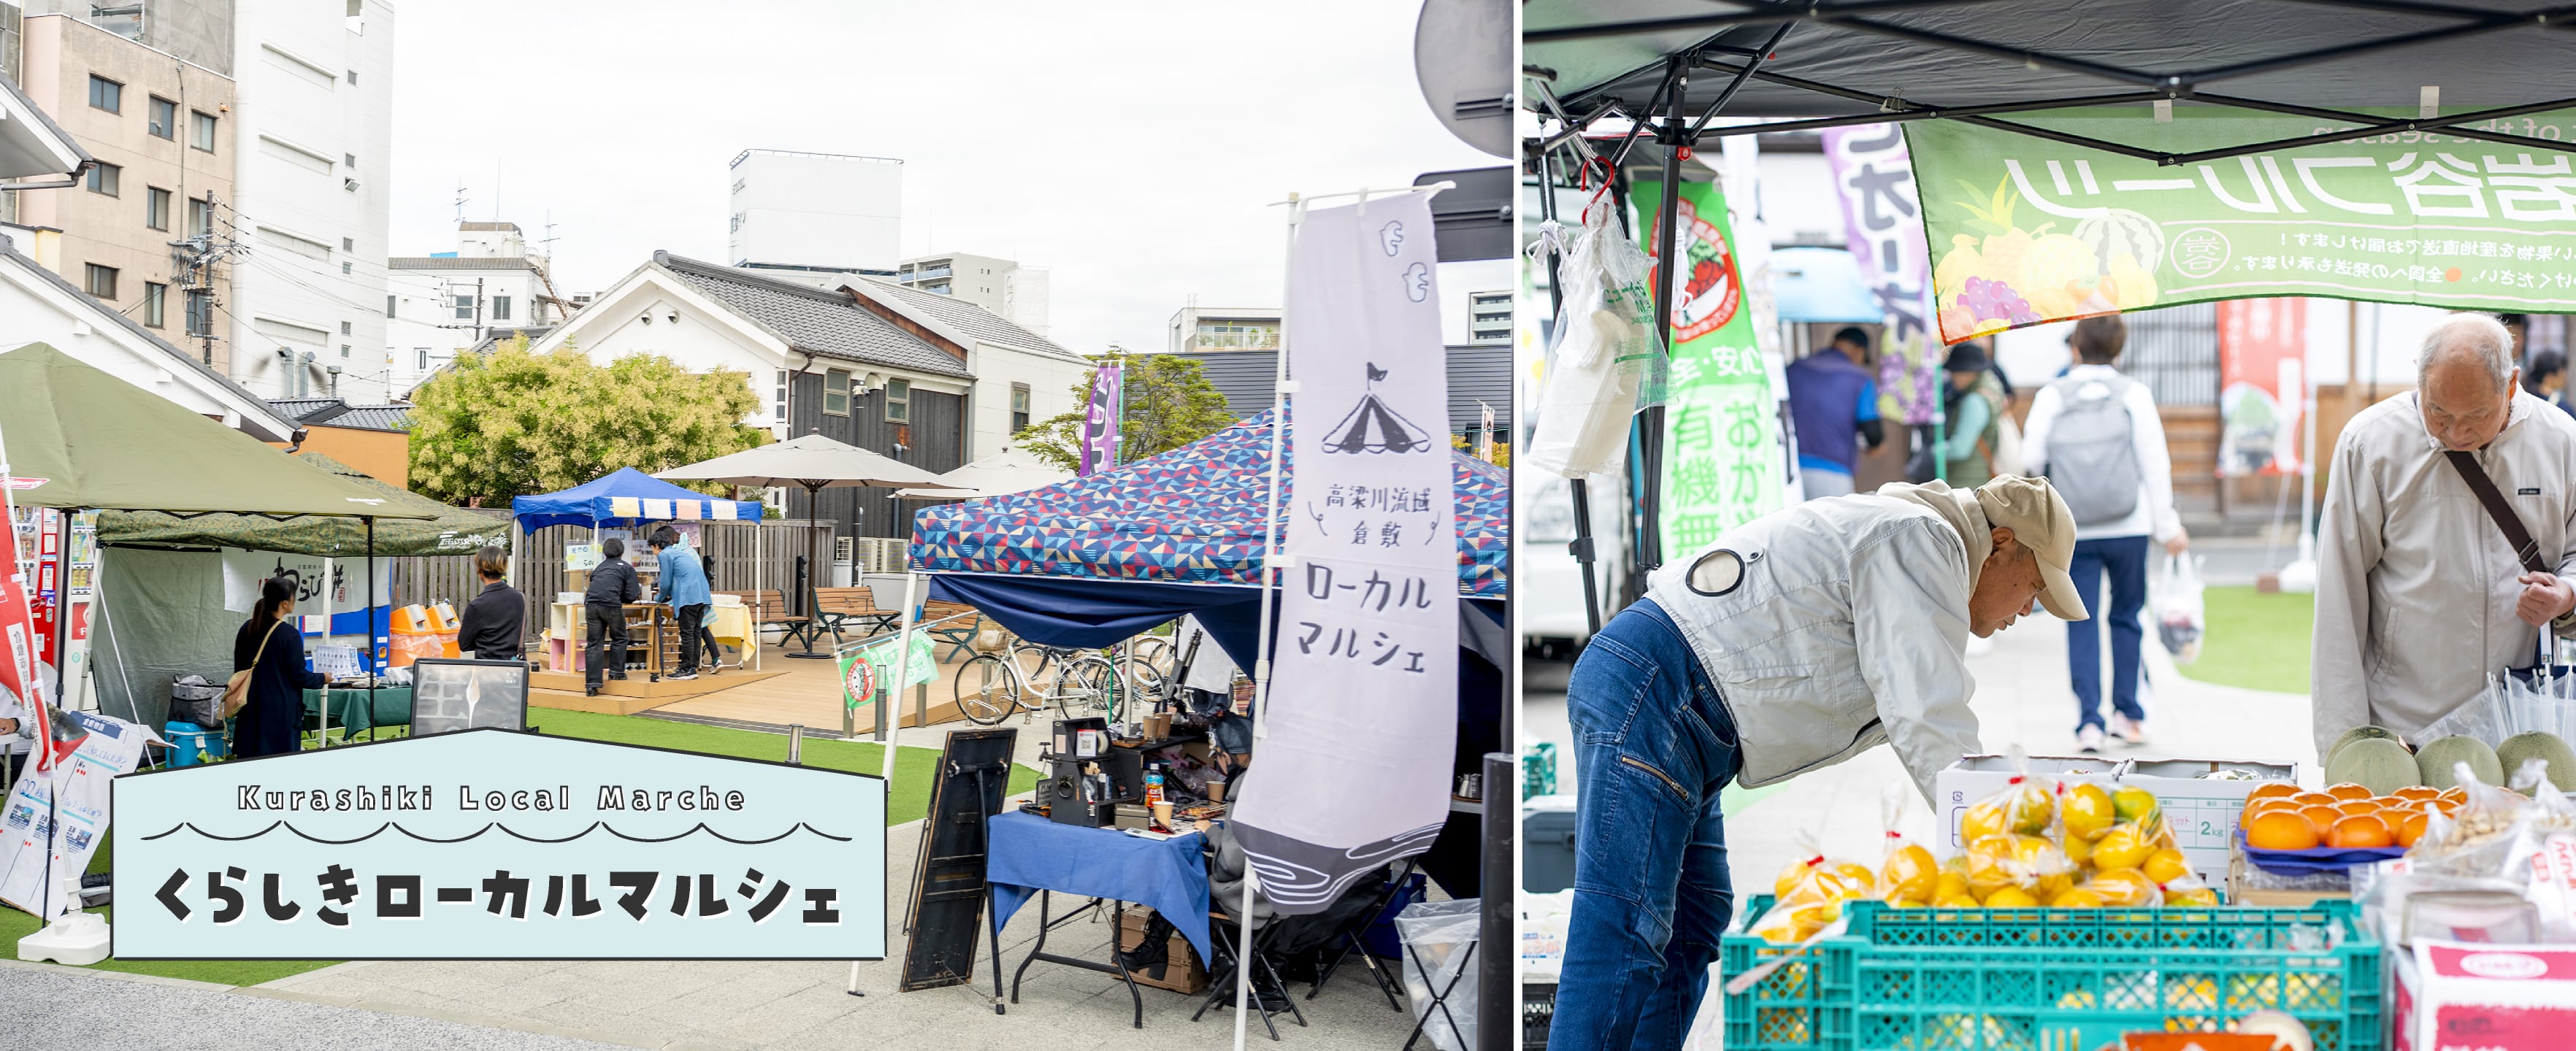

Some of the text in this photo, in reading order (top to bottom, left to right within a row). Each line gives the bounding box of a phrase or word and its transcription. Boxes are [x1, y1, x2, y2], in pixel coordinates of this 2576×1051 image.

[1327, 483, 1431, 513] 高梁川流域
[1351, 520, 1403, 547] 倉敷
[1306, 561, 1431, 612] ローカル
[1298, 621, 1425, 673] マルシェ
